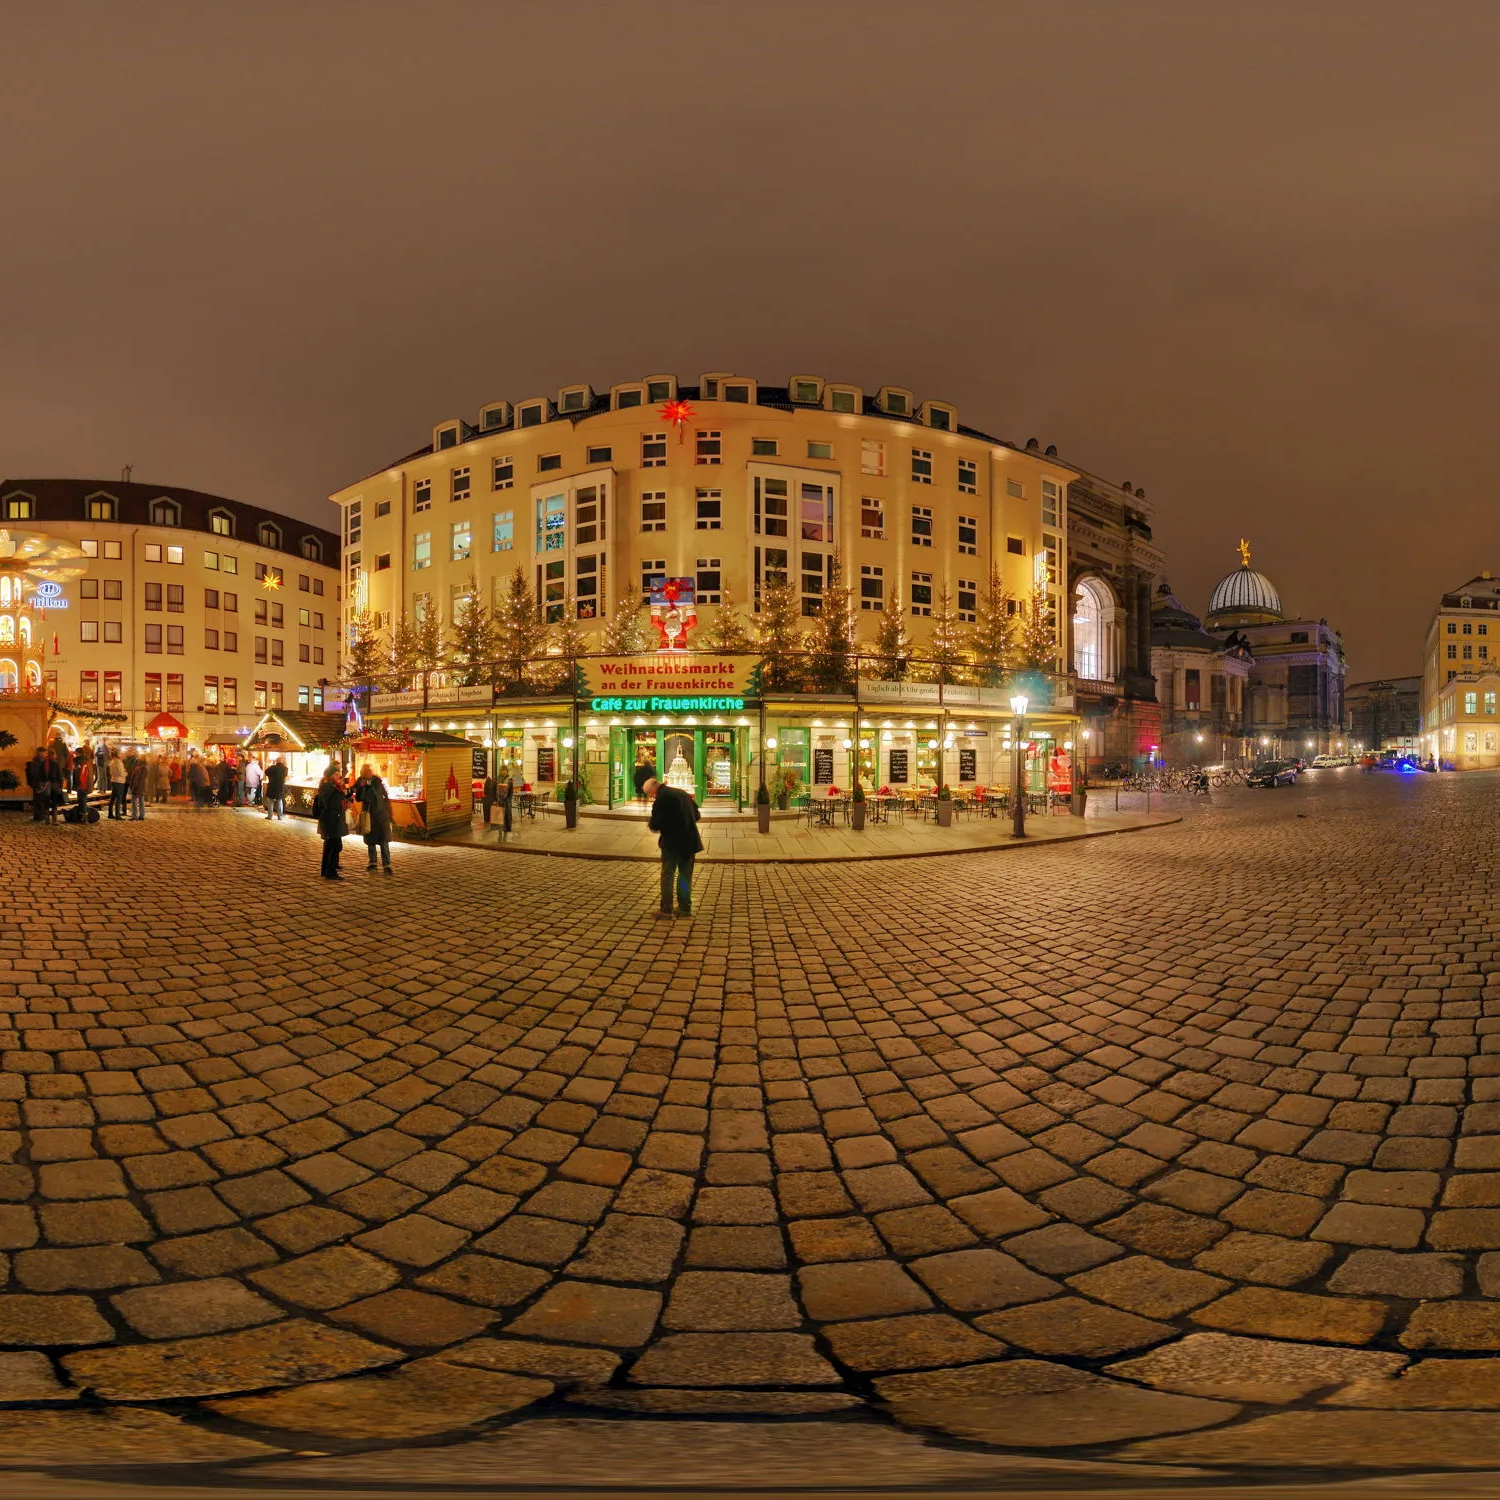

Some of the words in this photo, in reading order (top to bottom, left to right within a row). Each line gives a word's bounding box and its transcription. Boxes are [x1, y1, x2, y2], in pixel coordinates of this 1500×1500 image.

[29, 597, 68, 608] Hilton
[600, 662, 735, 675] Weihnachtsmarkt
[601, 681, 616, 690] an
[621, 680, 642, 689] der
[646, 679, 734, 690] Frauenkirche
[591, 697, 623, 711] Café
[625, 700, 647, 711] zur
[651, 697, 744, 711] Frauenkirche
